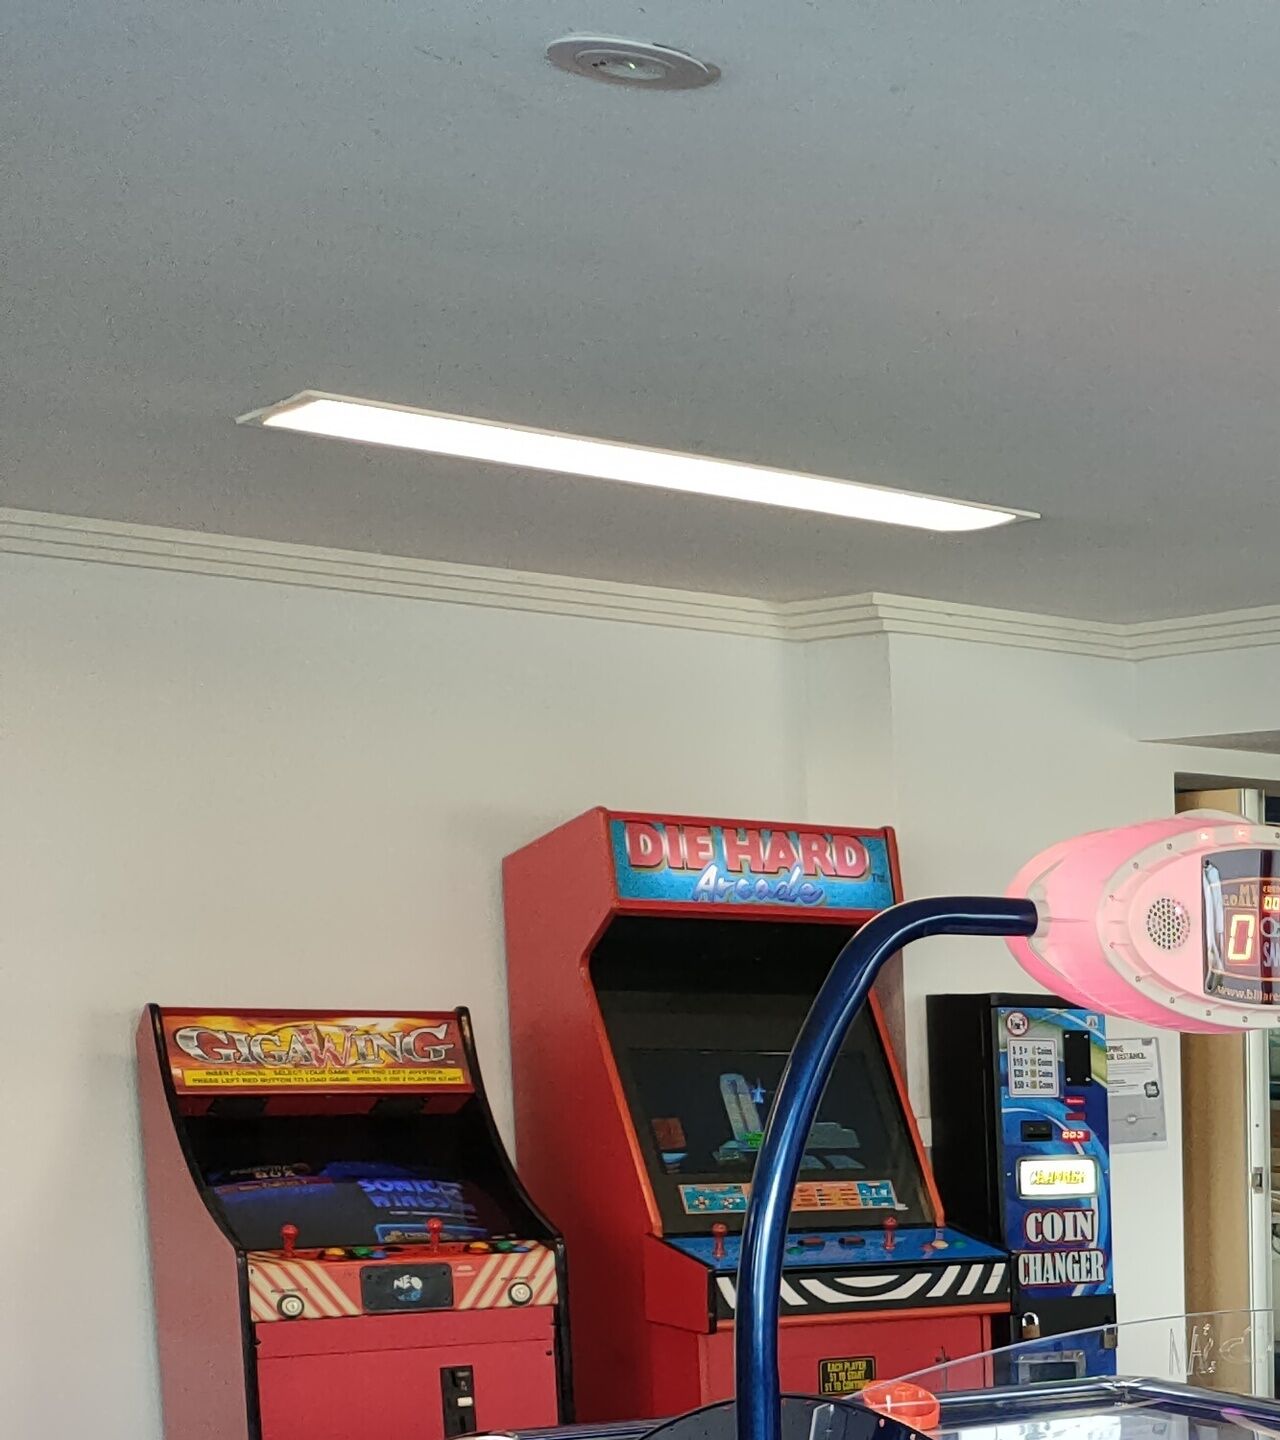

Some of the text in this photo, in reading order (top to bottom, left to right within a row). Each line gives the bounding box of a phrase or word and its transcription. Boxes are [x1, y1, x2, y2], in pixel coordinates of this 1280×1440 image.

[624, 821, 869, 878] DIE HARD
[692, 862, 824, 904] Arcade
[1263, 896, 1280, 912] 00
[1227, 914, 1256, 961] 0
[1026, 1210, 1094, 1243] COIN
[393, 1274, 423, 1290] NEO
[1018, 1250, 1105, 1286] CHANGER
